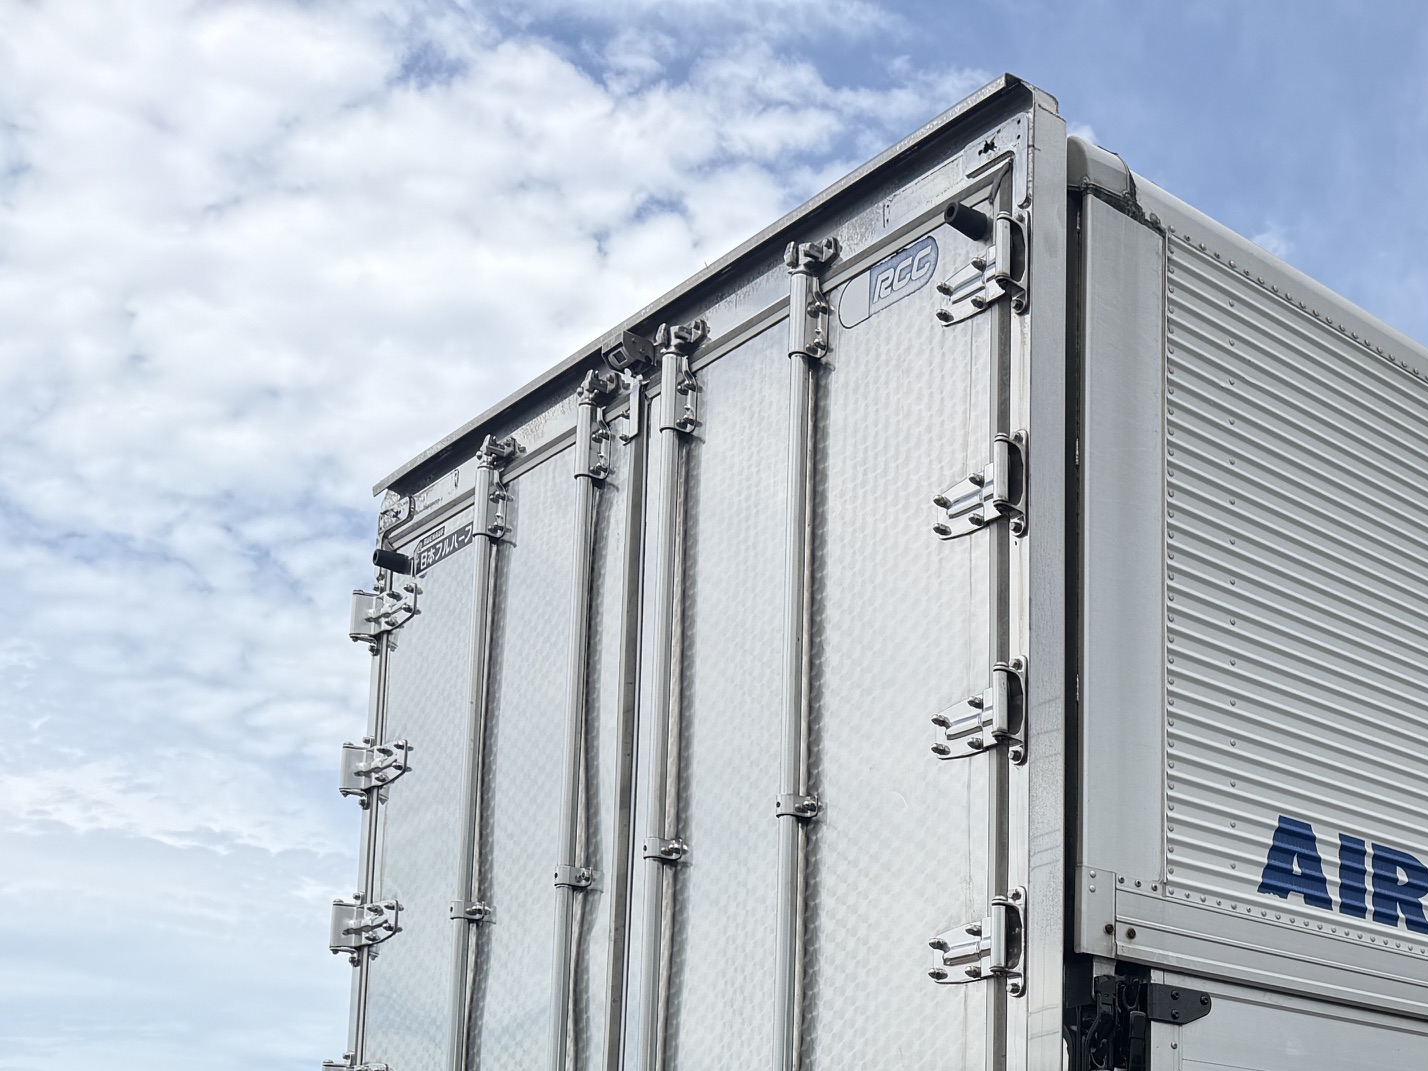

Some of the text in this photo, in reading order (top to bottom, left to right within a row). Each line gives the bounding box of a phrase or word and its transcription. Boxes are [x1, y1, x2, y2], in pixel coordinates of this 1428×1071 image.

[420, 523, 473, 570] 日本フルハーフ
